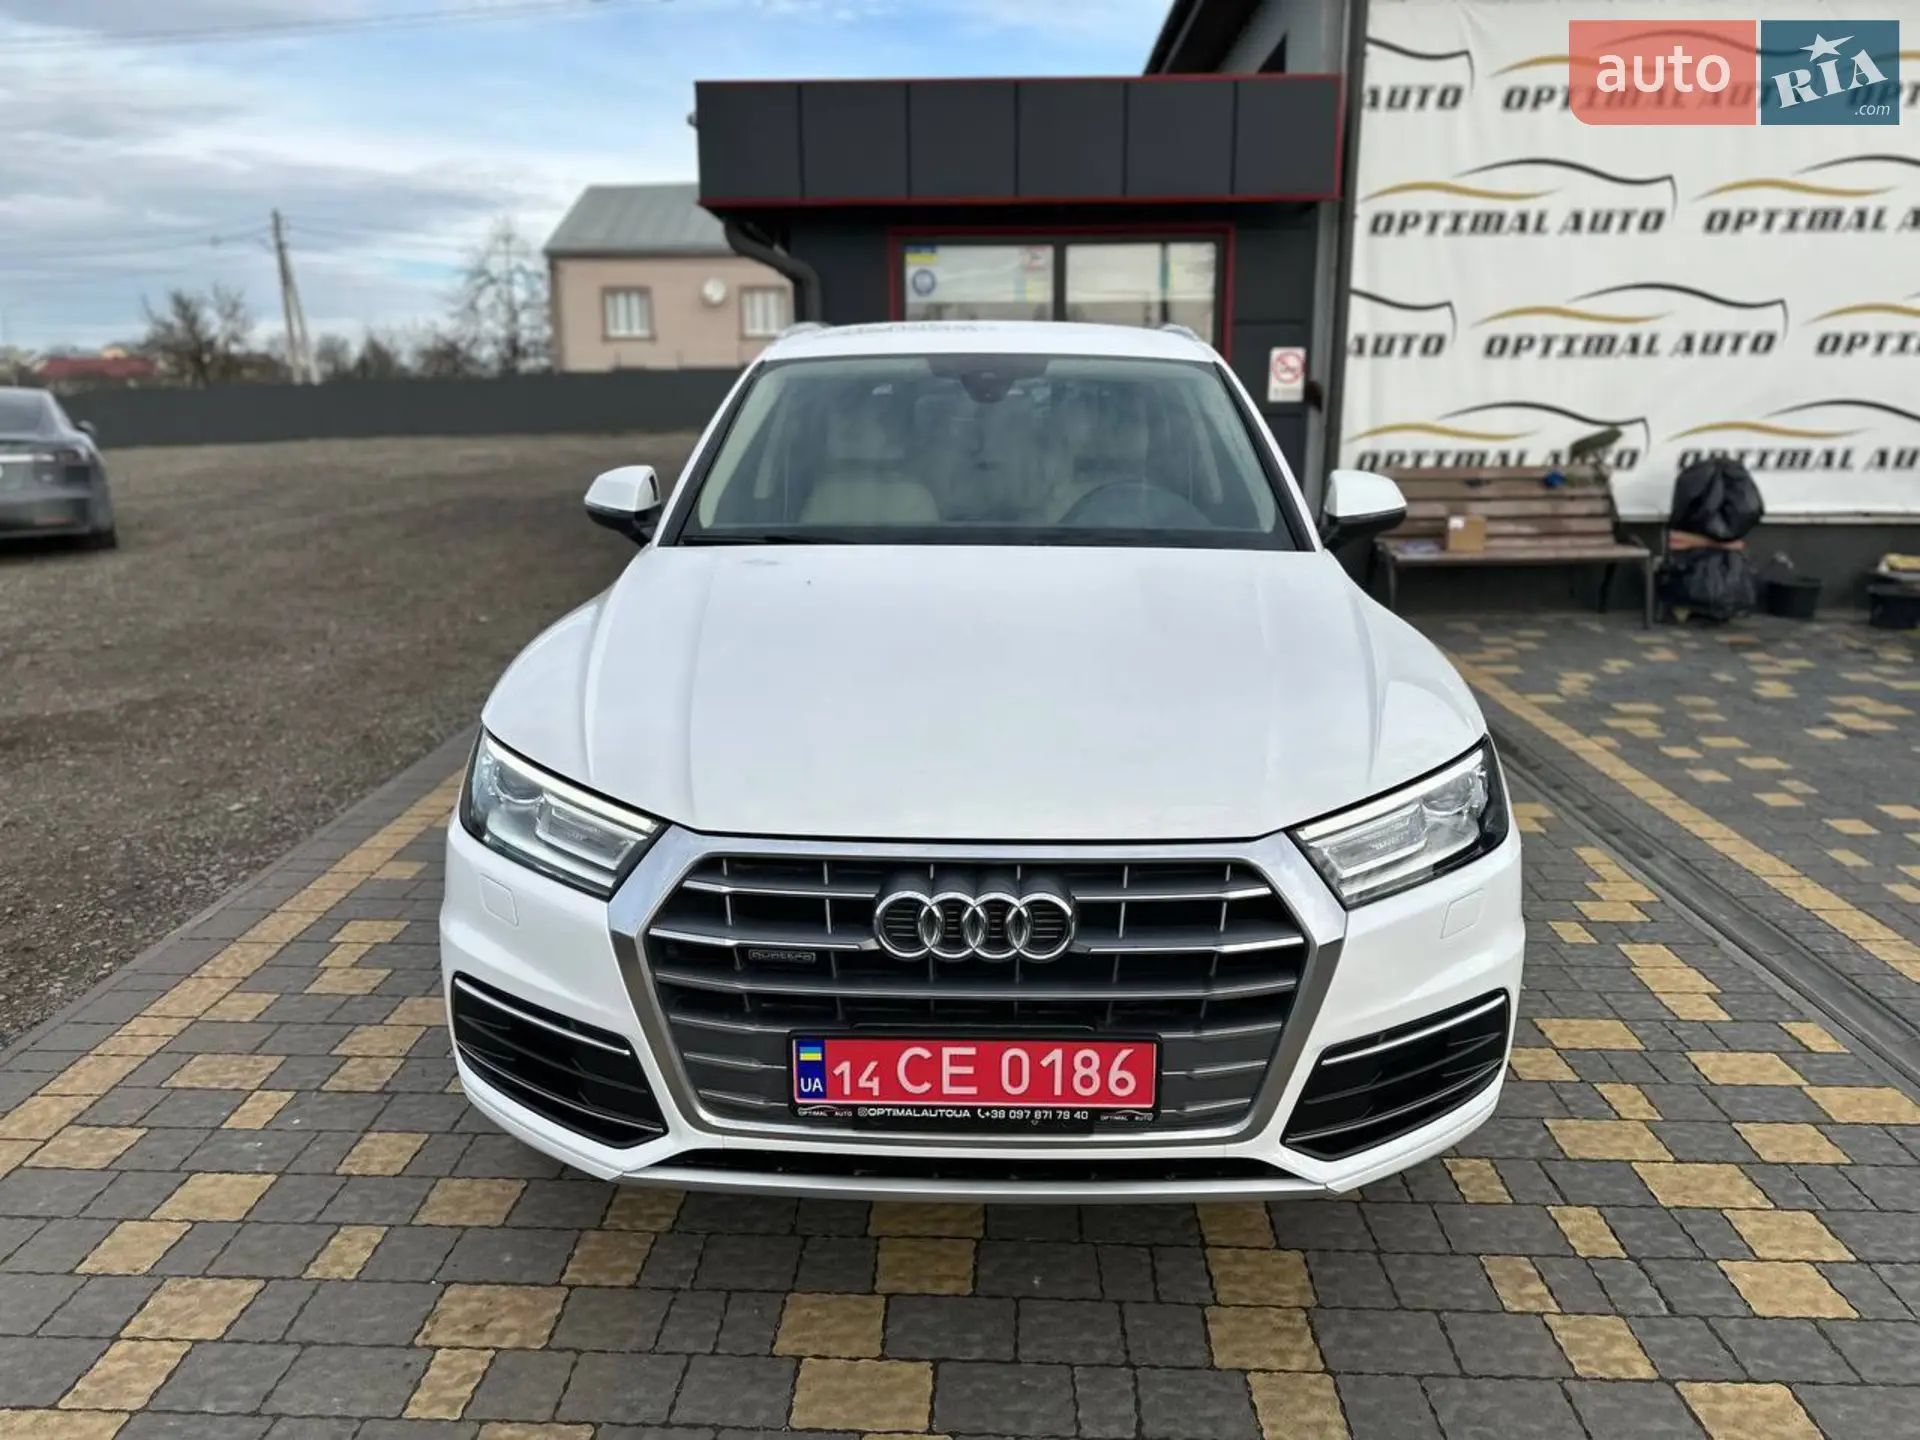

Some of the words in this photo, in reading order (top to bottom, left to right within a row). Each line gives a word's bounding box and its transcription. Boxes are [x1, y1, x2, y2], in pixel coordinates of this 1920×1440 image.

[1369, 208, 1551, 237] OPTIMAL
[1558, 207, 1666, 236] AUTO
[1703, 206, 1889, 235] OPTIMAL
[1483, 332, 1661, 359] OPTIMAL
[1668, 331, 1778, 358] AUTO
[1814, 330, 1920, 357] OPTI
[800, 1077, 823, 1093] UA
[832, 1060, 880, 1096] 14
[897, 1046, 979, 1095] CE
[1000, 1048, 1137, 1097] 0186
[1008, 1109, 1031, 1119] 097
[1073, 1110, 1089, 1120] 40
